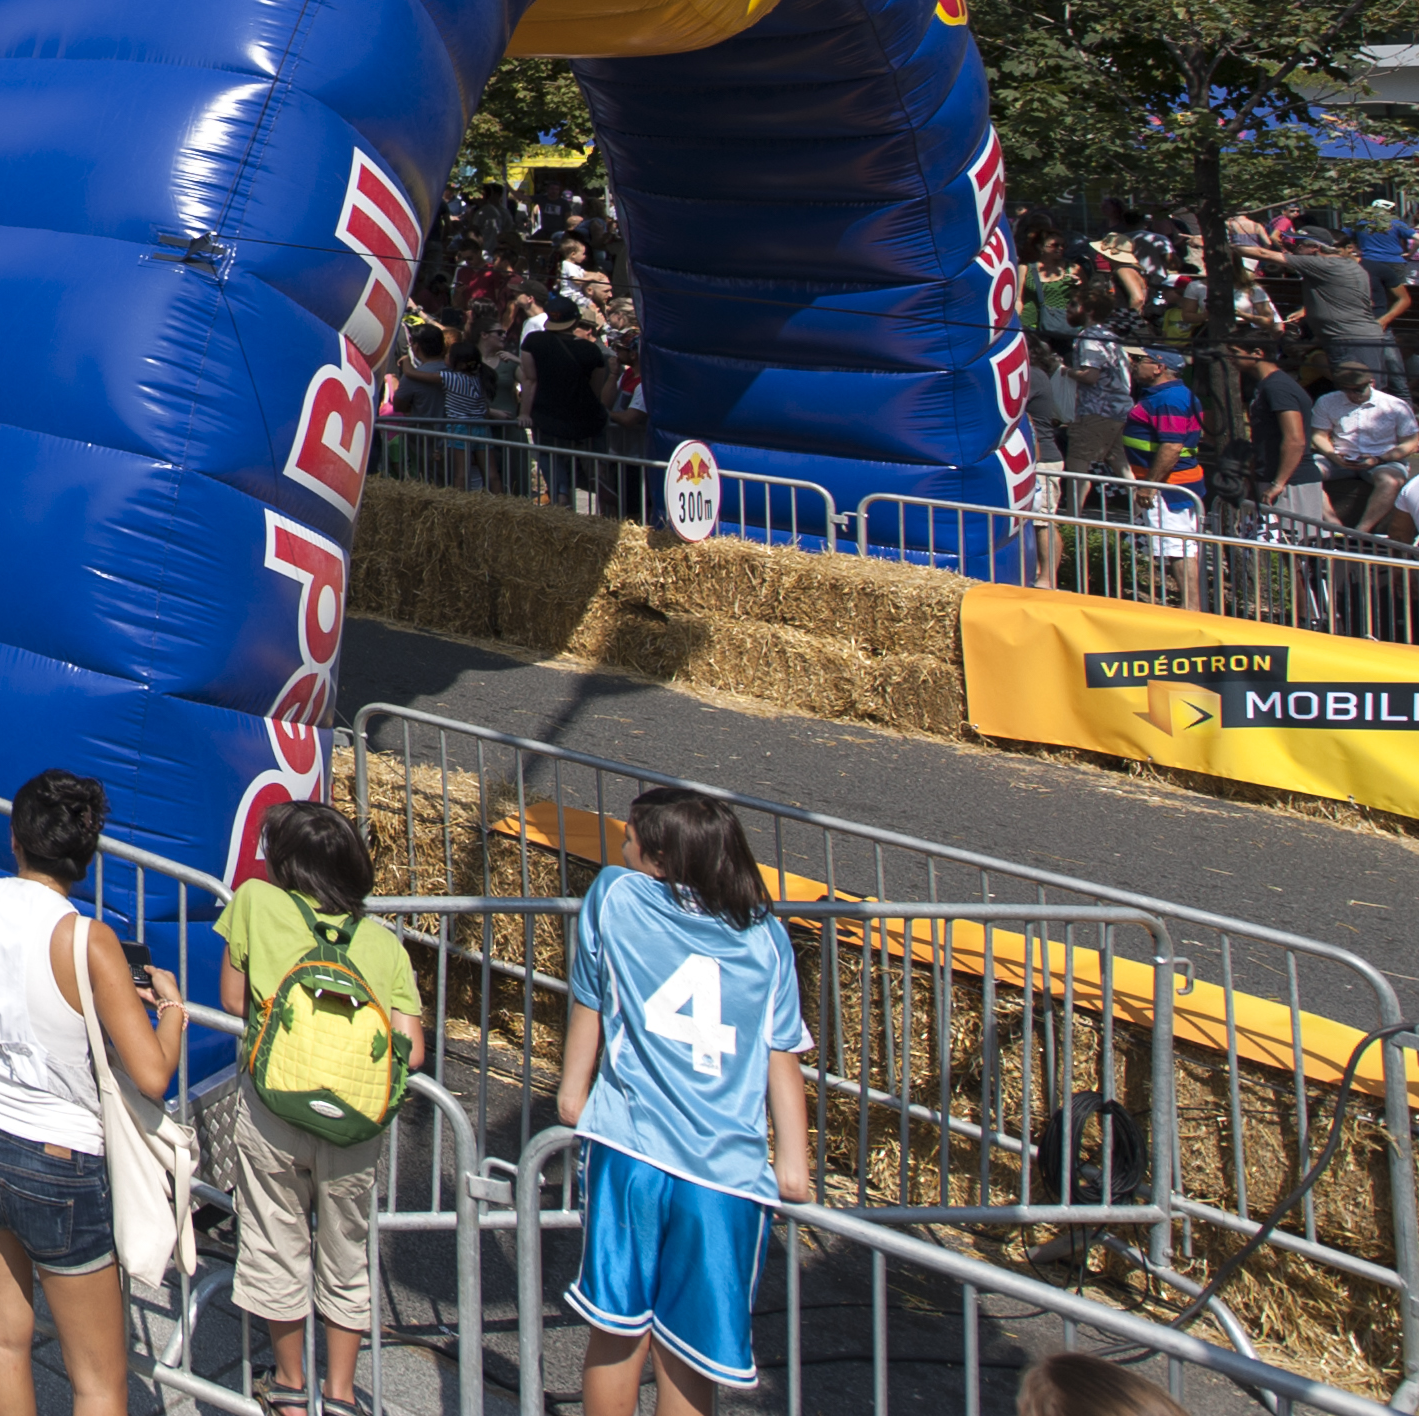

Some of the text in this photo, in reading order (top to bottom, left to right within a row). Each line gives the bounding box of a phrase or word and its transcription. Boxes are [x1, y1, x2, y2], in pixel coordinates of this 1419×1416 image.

[288, 152, 421, 516] Bull
[679, 490, 712, 523] 300m
[1100, 655, 1271, 677] VIDÉOTRON
[1245, 690, 1419, 722] MOBIL
[643, 953, 736, 1077] 4
